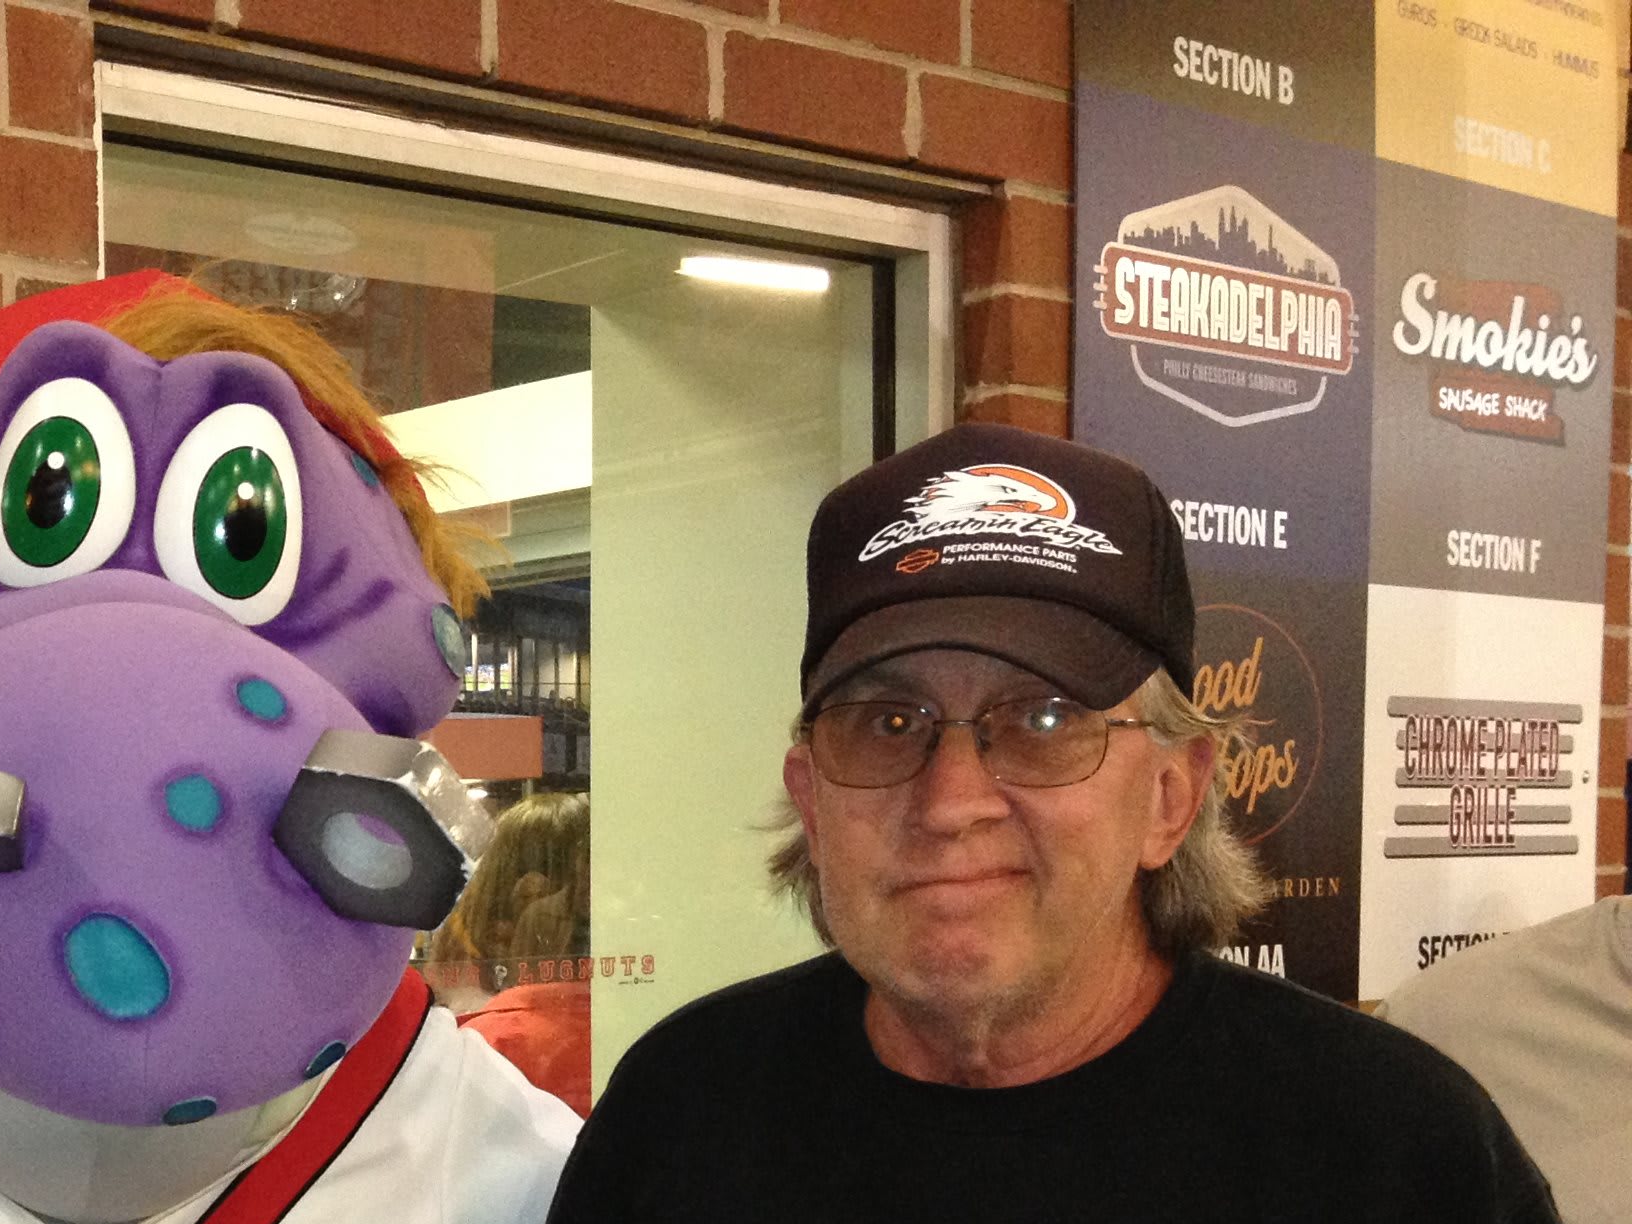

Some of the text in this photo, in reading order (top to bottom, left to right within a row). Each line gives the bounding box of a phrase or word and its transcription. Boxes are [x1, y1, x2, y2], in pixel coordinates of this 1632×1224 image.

[1173, 36, 1294, 105] SECTION B
[1454, 115, 1552, 175] SECTION C
[1114, 257, 1342, 361] STEAKADELPHIA
[1393, 273, 1597, 383] Smokie's
[1439, 386, 1548, 422] SAUSAGE SHACK
[1018, 515, 1123, 555] Eagle
[1170, 499, 1288, 549] SECTION E
[941, 556, 956, 565] by
[943, 542, 1077, 563] PERFORMANCE PARTS
[1447, 530, 1542, 574] SECTION F
[1193, 636, 1264, 713] ood
[1405, 715, 1559, 781] CHROME PLATED
[1450, 784, 1517, 848] GRILLE
[518, 955, 655, 984] LUGNUTS
